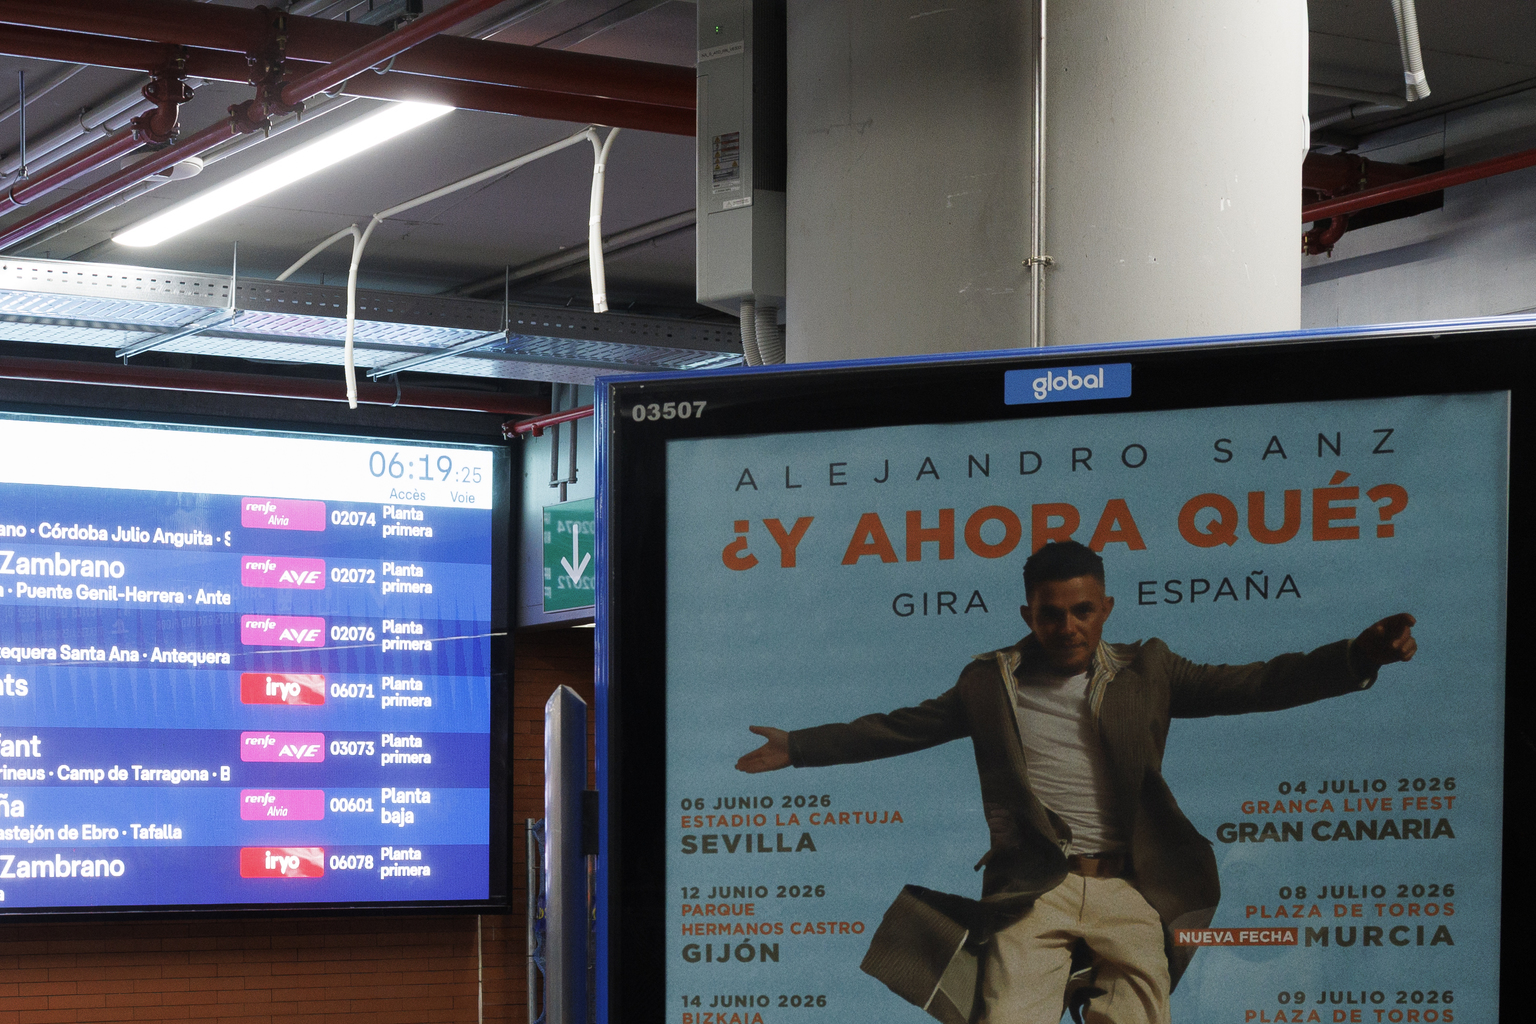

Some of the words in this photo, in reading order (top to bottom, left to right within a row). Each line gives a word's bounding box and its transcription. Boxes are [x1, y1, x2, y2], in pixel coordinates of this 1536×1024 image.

[1032, 368, 1104, 400] global
[632, 401, 707, 421] 03507
[736, 443, 1147, 491] ALEJANDRO
[1214, 428, 1394, 463] SANZ
[331, 510, 376, 526] 02074
[722, 517, 814, 571] ¿Y
[842, 499, 1146, 570] AHORA
[1178, 471, 1408, 547] QUÉ?
[0, 551, 124, 578] Zambrano
[331, 568, 375, 583] 02072
[892, 590, 988, 617] GIRA
[1138, 570, 1301, 605] ESPAÑA
[331, 626, 375, 641] 02076
[331, 683, 374, 698] 06071
[330, 741, 374, 755] 03073
[1279, 781, 1307, 795] 04
[1318, 779, 1387, 794] JULIO
[1398, 777, 1456, 792] 2026
[330, 798, 374, 812] 00601
[681, 798, 704, 811] 06
[713, 796, 773, 810] JUNIO
[782, 794, 831, 808] 2026
[1241, 799, 1334, 814] GRANCA
[1344, 798, 1392, 812] LIVE
[1402, 796, 1456, 810] FEST
[681, 814, 766, 828] ESTADIO
[776, 813, 800, 826] LA
[809, 811, 903, 825] CARTUJA
[61, 825, 79, 841] de
[82, 824, 119, 840] Ebro
[130, 824, 182, 839] Tafalla
[1216, 821, 1303, 843] GRAN
[1312, 818, 1455, 841] CANARIA
[682, 832, 816, 854] SEVILLA
[0, 854, 124, 878] Zambrano
[330, 855, 373, 869] 06078
[682, 903, 754, 916] PARQUE
[682, 922, 783, 935] HERMANOS
[790, 921, 865, 935] CASTRO
[1179, 932, 1234, 943] NUEVA
[1239, 930, 1294, 942] FECHA
[1306, 925, 1454, 947] MURCIA
[682, 938, 779, 963] GIJÓN
[683, 1012, 763, 1024] BIZKAIA
